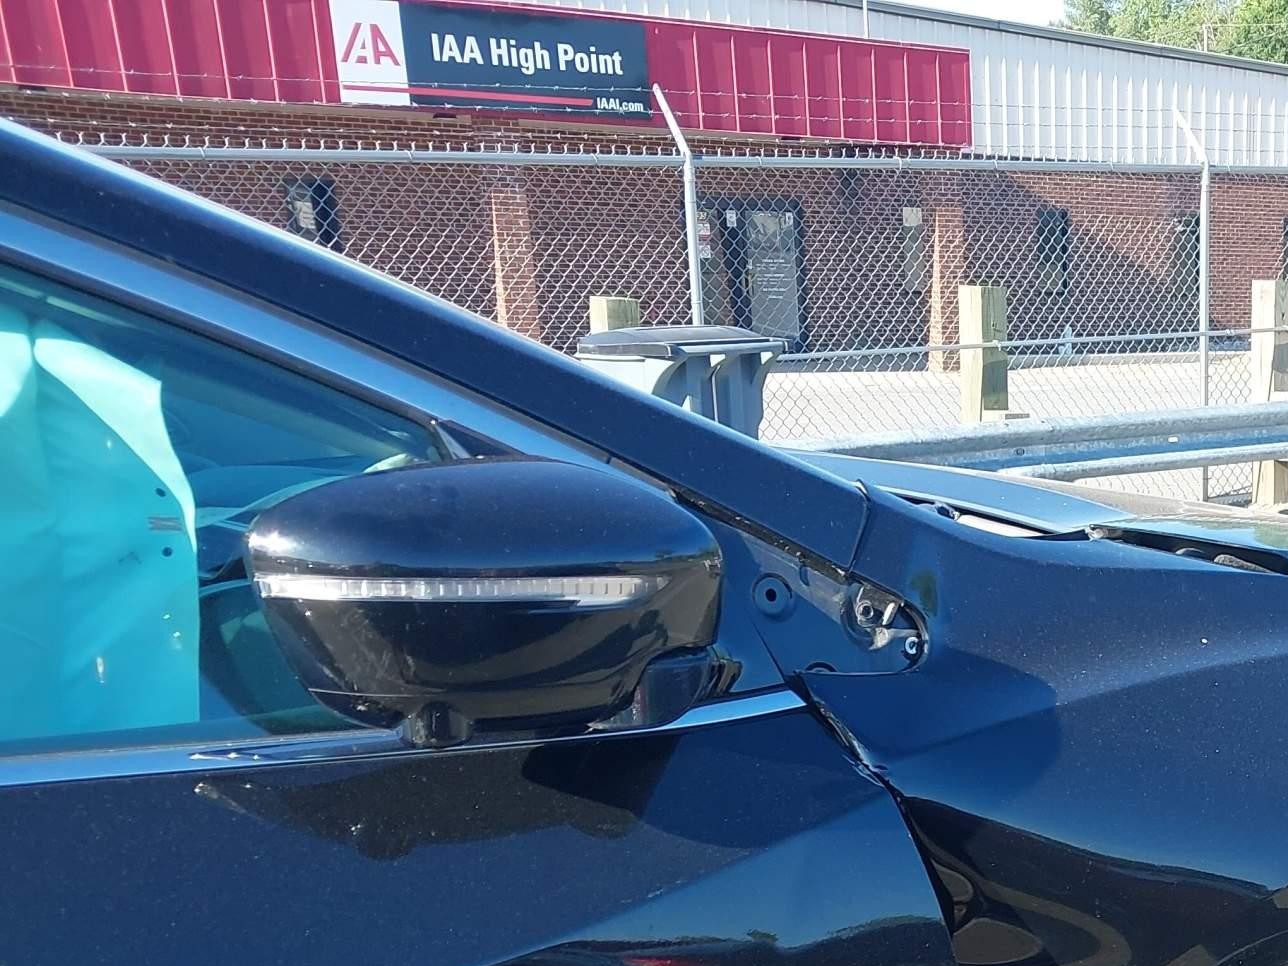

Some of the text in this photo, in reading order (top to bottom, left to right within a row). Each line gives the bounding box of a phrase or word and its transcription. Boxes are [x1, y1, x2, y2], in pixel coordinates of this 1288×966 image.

[431, 33, 624, 76] IAA High Point
[596, 97, 645, 113] IAAI.com
